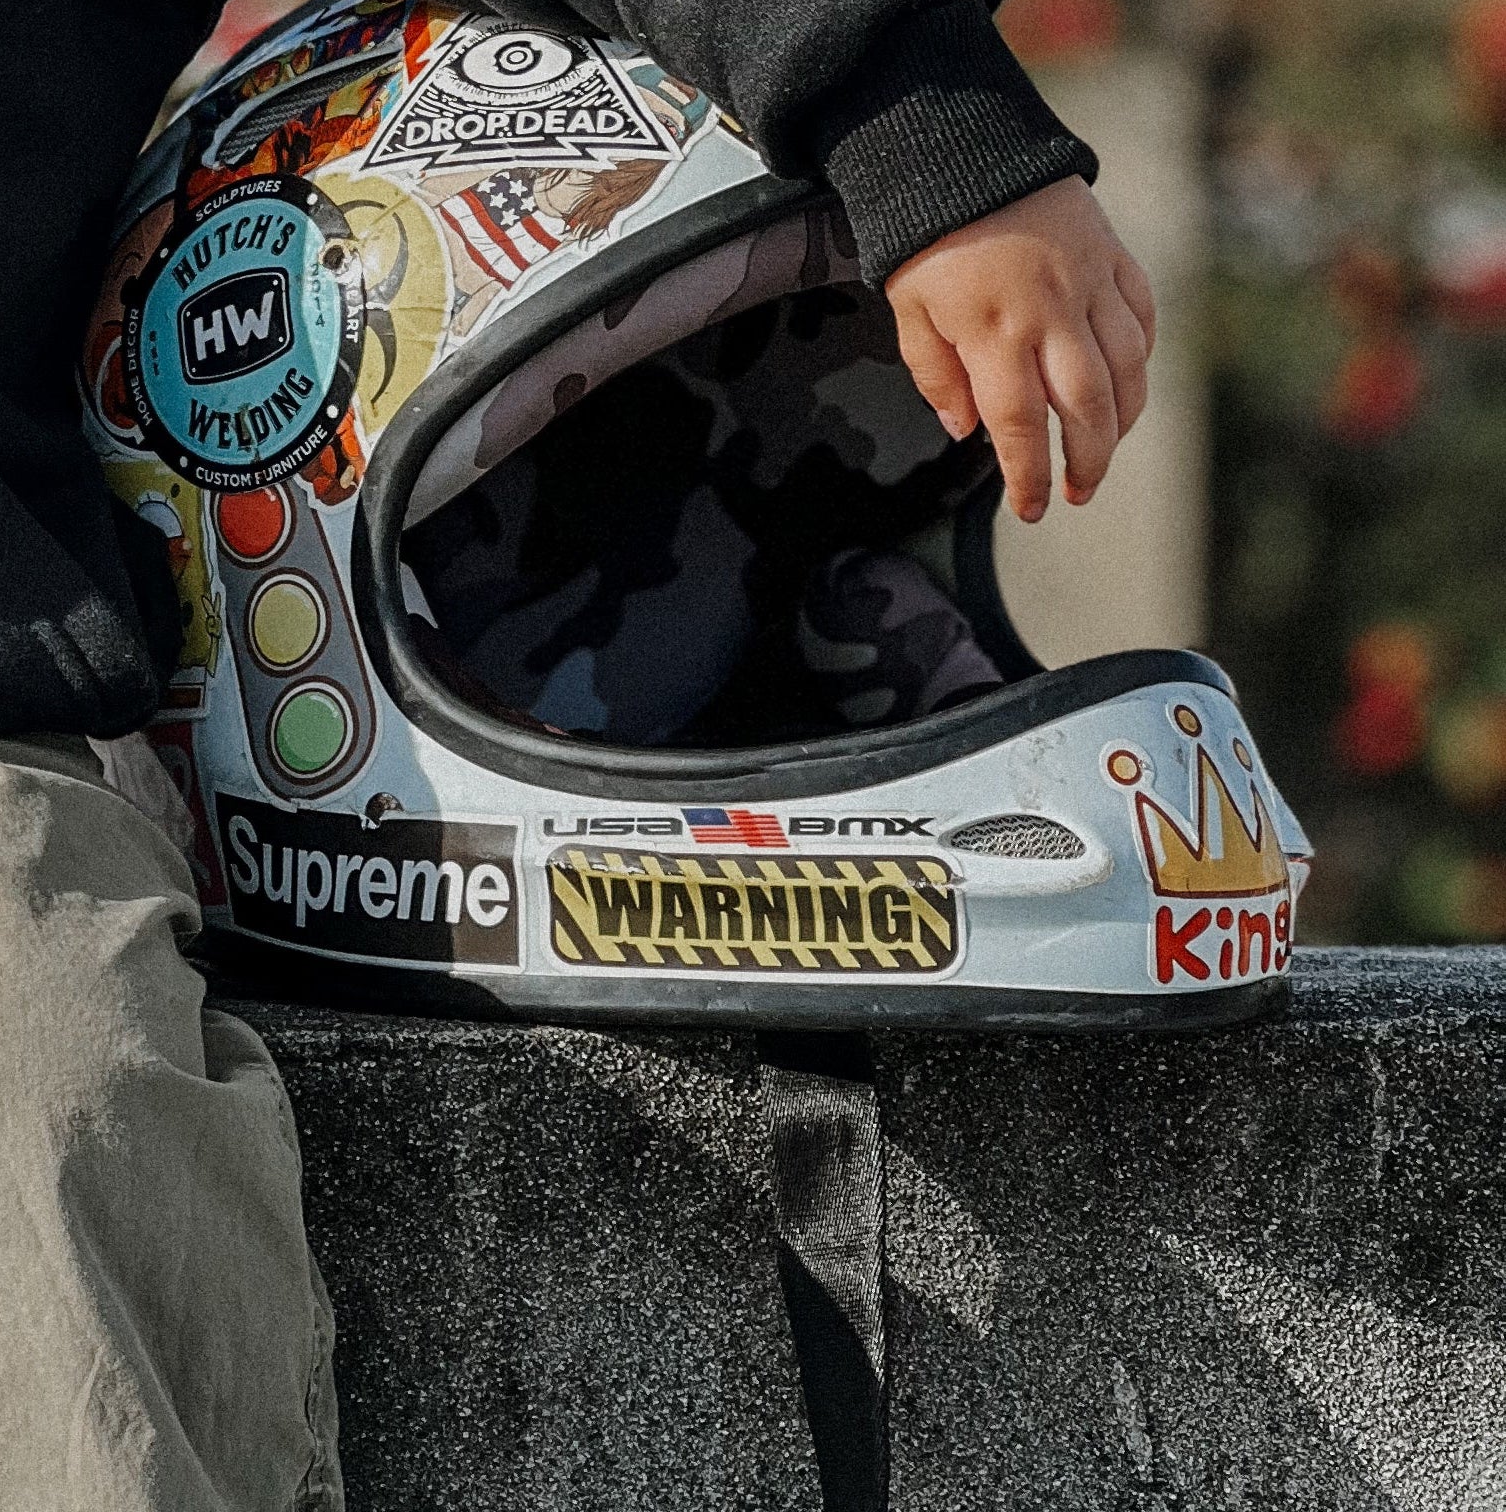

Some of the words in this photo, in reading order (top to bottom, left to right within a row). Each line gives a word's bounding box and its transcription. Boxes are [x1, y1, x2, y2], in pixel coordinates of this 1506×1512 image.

[405, 114, 510, 146] DROP
[516, 109, 625, 135] DEAD
[195, 180, 282, 222] SCULPTURES
[171, 214, 296, 292] HUTCH'S
[127, 308, 139, 370] DECOR
[193, 291, 274, 361] HW
[131, 375, 153, 426] HOME
[187, 367, 314, 450] WELDING
[196, 466, 252, 487] CUSTOM
[254, 425, 328, 485] FURNITURE
[228, 815, 510, 928] Supreme
[588, 876, 913, 944] WARNING
[1156, 900, 1291, 984] King
